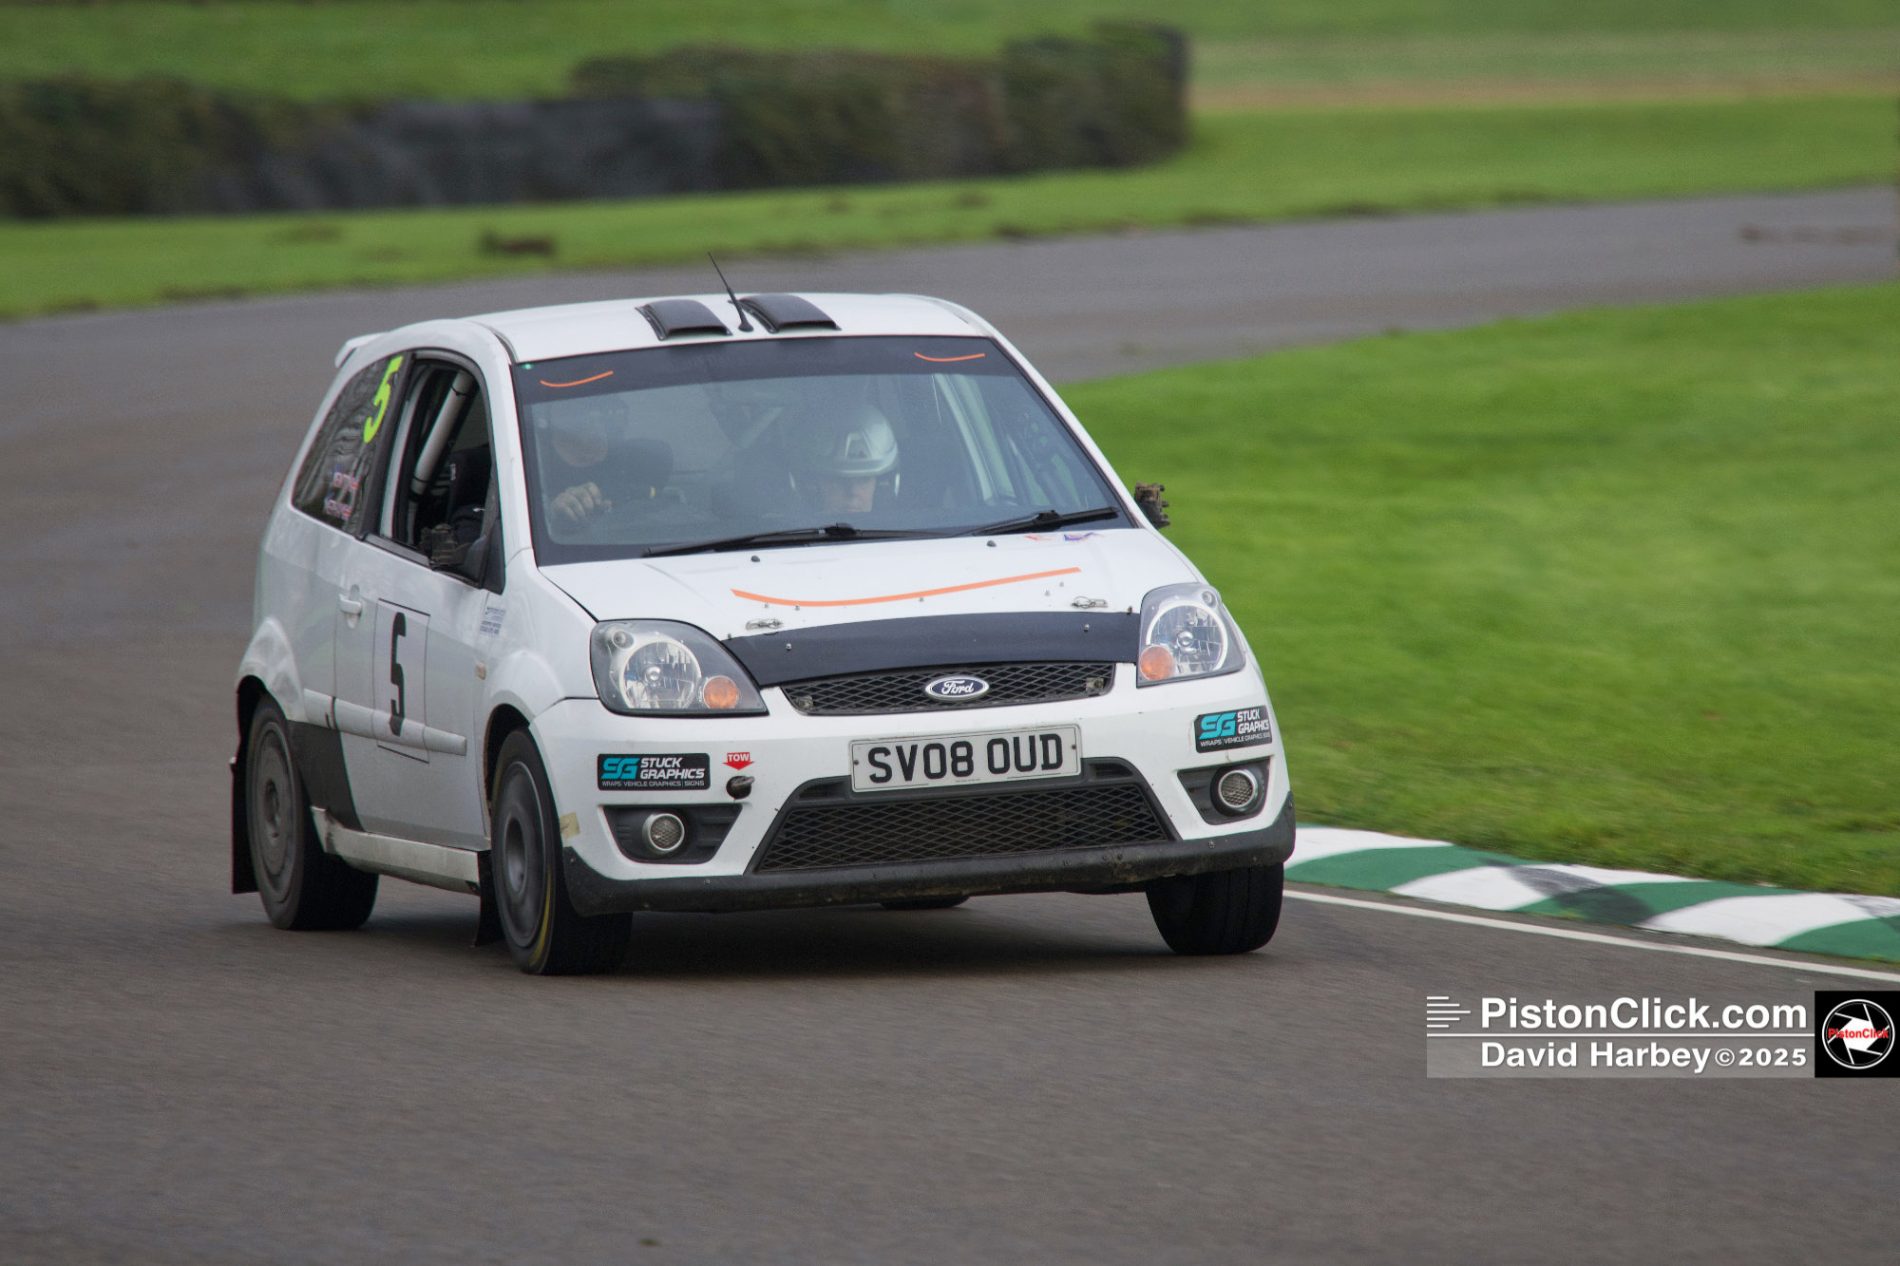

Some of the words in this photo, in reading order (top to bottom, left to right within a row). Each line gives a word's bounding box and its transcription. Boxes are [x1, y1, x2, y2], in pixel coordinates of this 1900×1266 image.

[363, 355, 404, 443] 5
[390, 611, 407, 736] 5
[941, 680, 975, 695] Ford
[1237, 708, 1260, 722] STUCK
[1199, 712, 1236, 739] SG
[1200, 739, 1222, 747] WRAPS
[640, 757, 683, 768] STUCK
[727, 754, 750, 762] TOW
[867, 740, 975, 784] SV08
[986, 733, 1063, 775] OUD
[601, 757, 640, 780] SG
[640, 768, 705, 780] GRAPHICS
